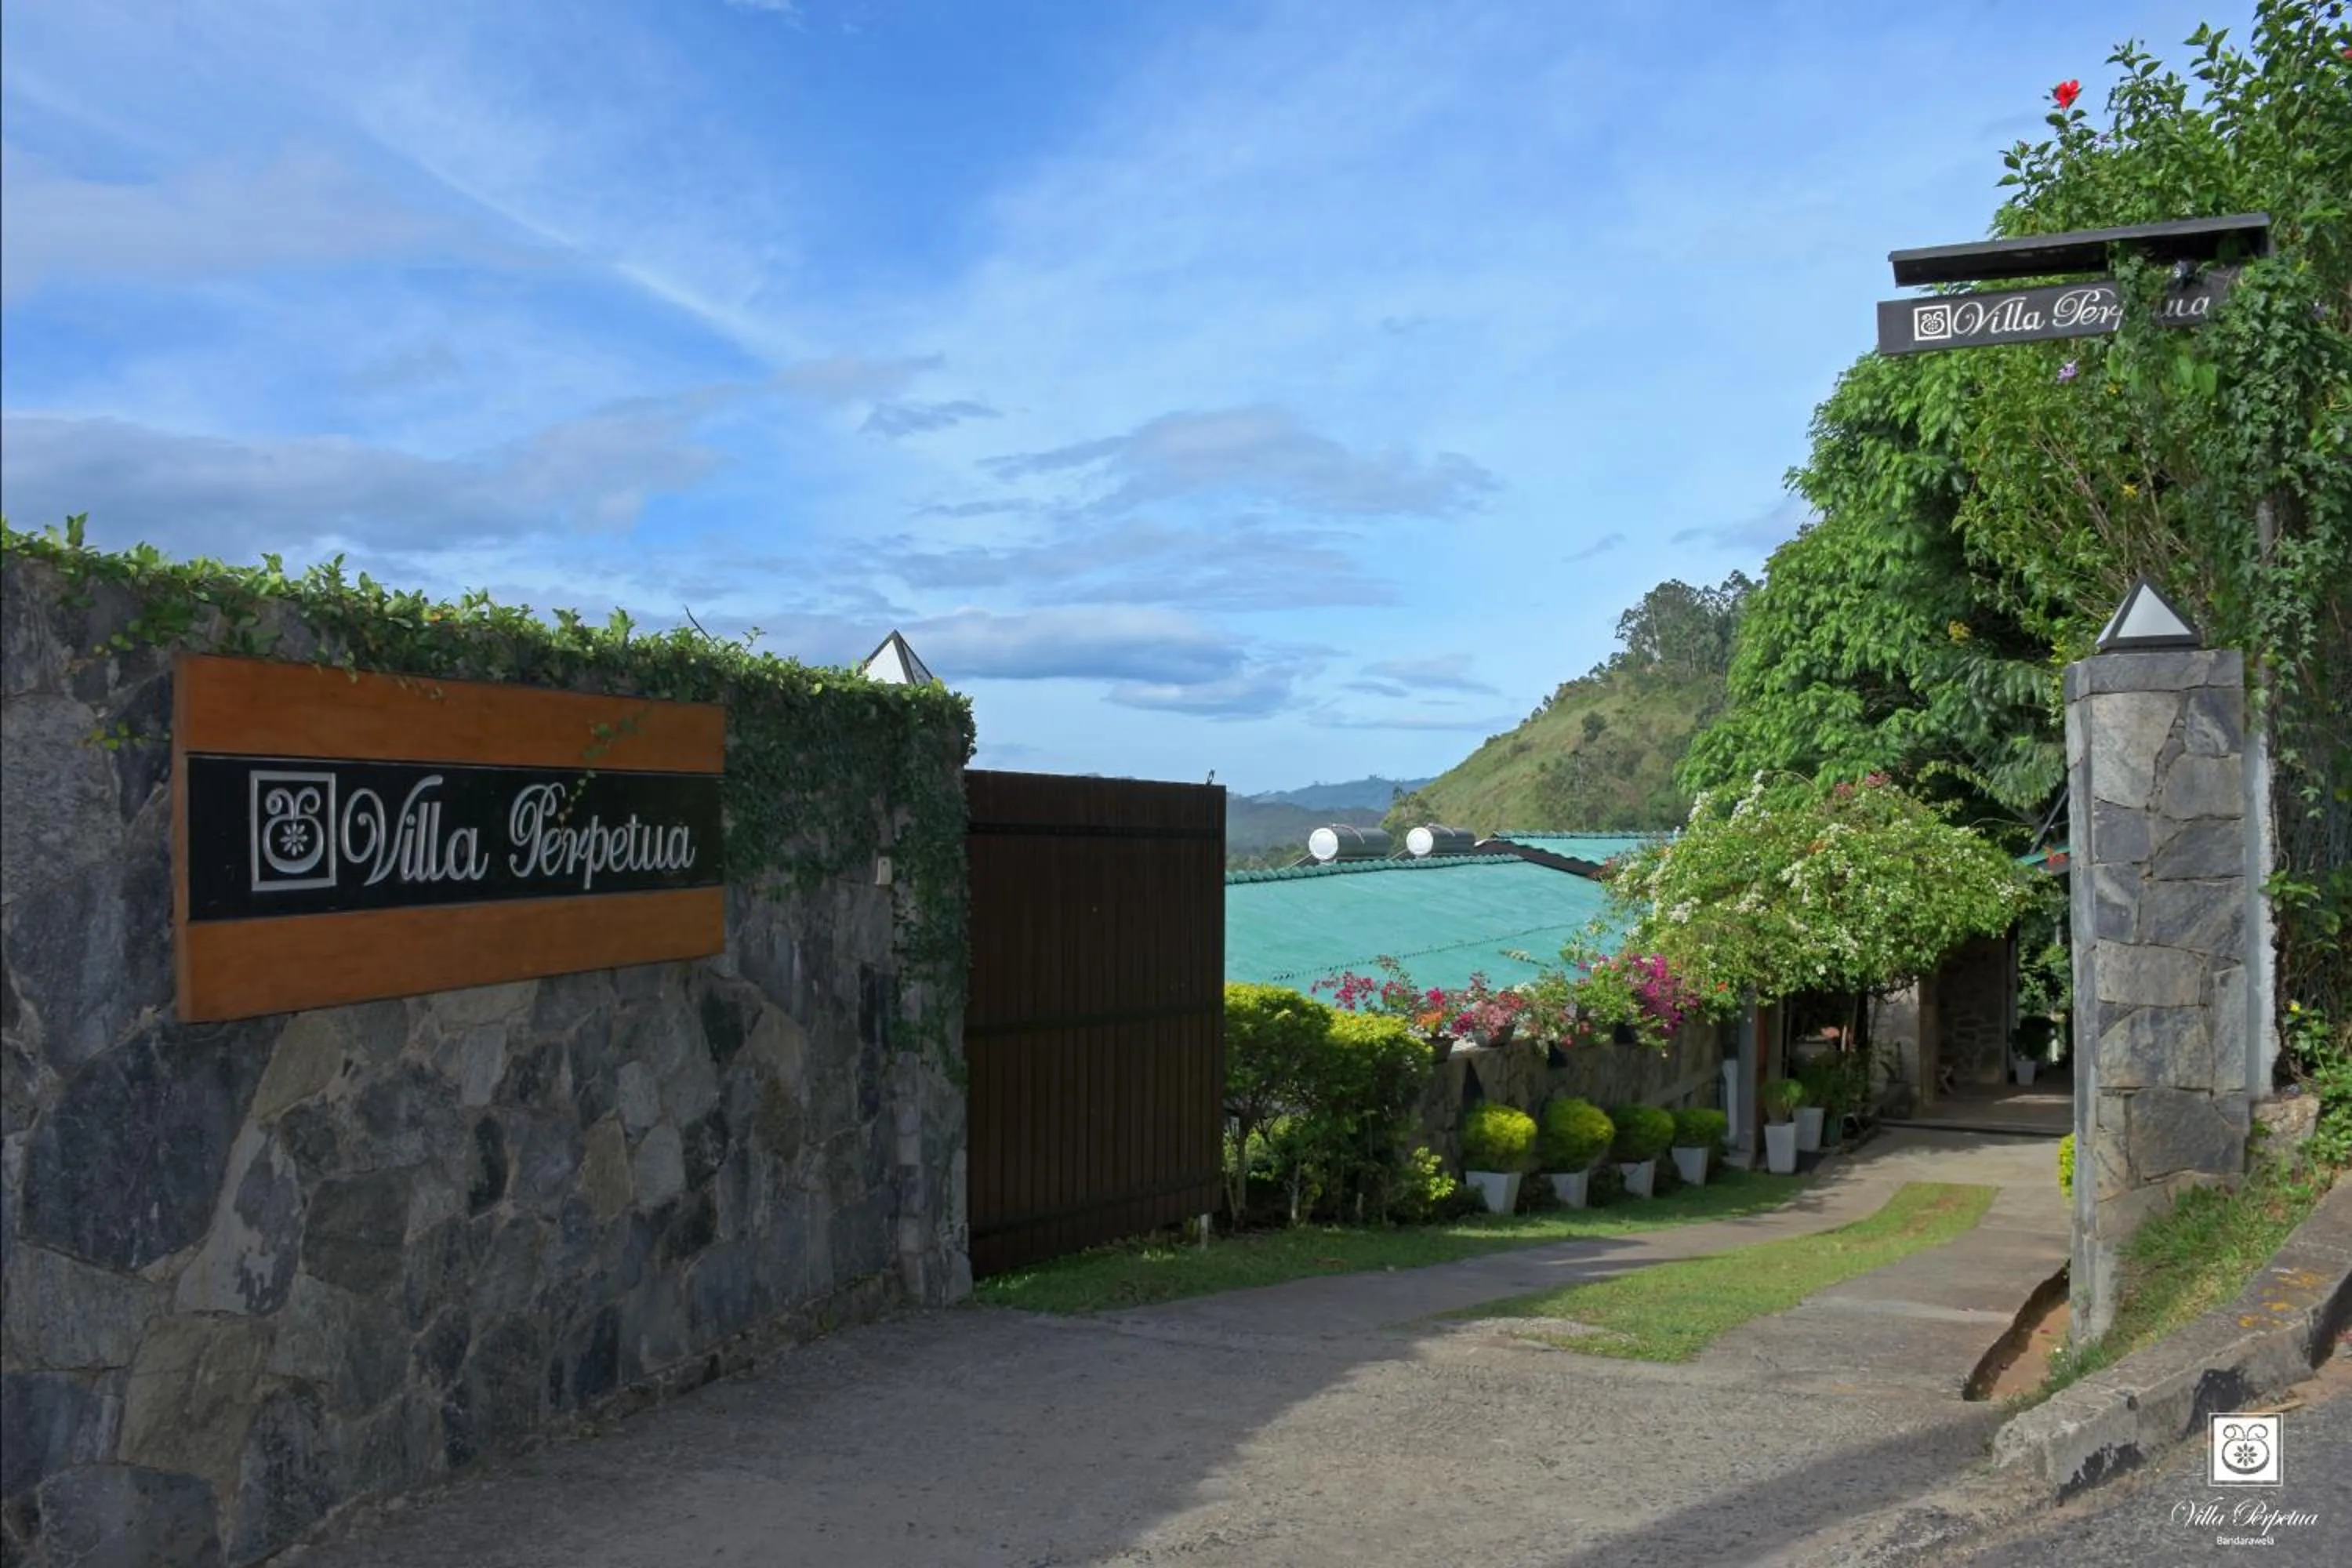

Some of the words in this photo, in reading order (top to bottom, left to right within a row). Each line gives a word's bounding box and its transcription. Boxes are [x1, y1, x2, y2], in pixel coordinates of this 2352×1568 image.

[1952, 296, 2045, 336] Villa
[2052, 288, 2210, 332] Perua
[341, 775, 488, 886] Villa
[508, 783, 695, 890] Perpetua
